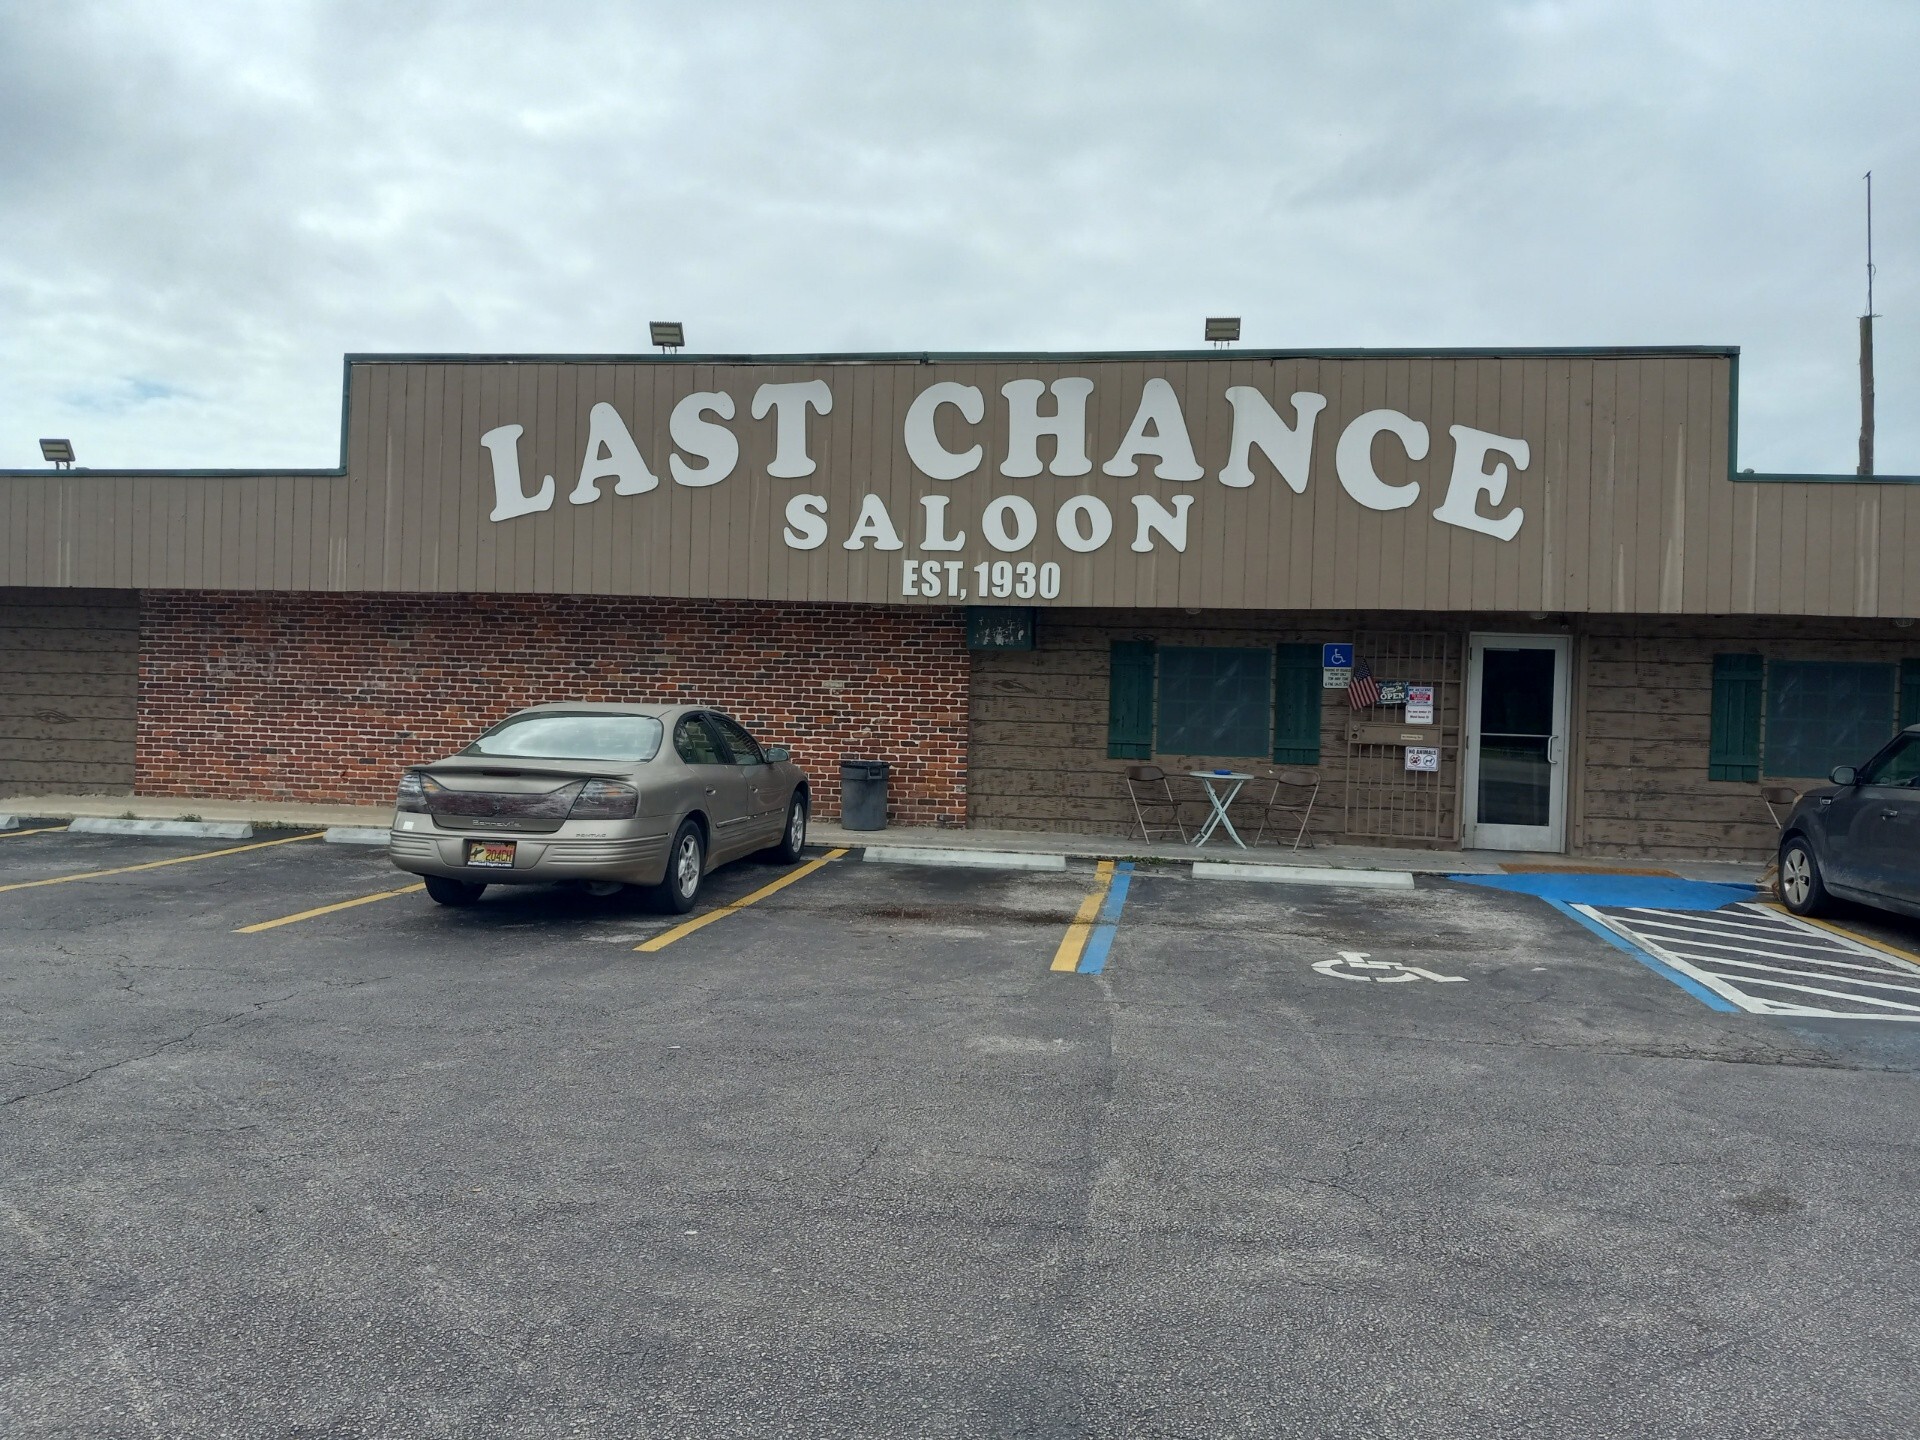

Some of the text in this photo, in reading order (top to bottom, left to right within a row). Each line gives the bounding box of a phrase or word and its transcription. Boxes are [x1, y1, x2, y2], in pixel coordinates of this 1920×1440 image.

[480, 377, 1531, 542] LAST CHANCE
[783, 493, 1195, 553] SALOON
[974, 561, 1061, 600] 1930
[1380, 692, 1405, 700] OPEN
